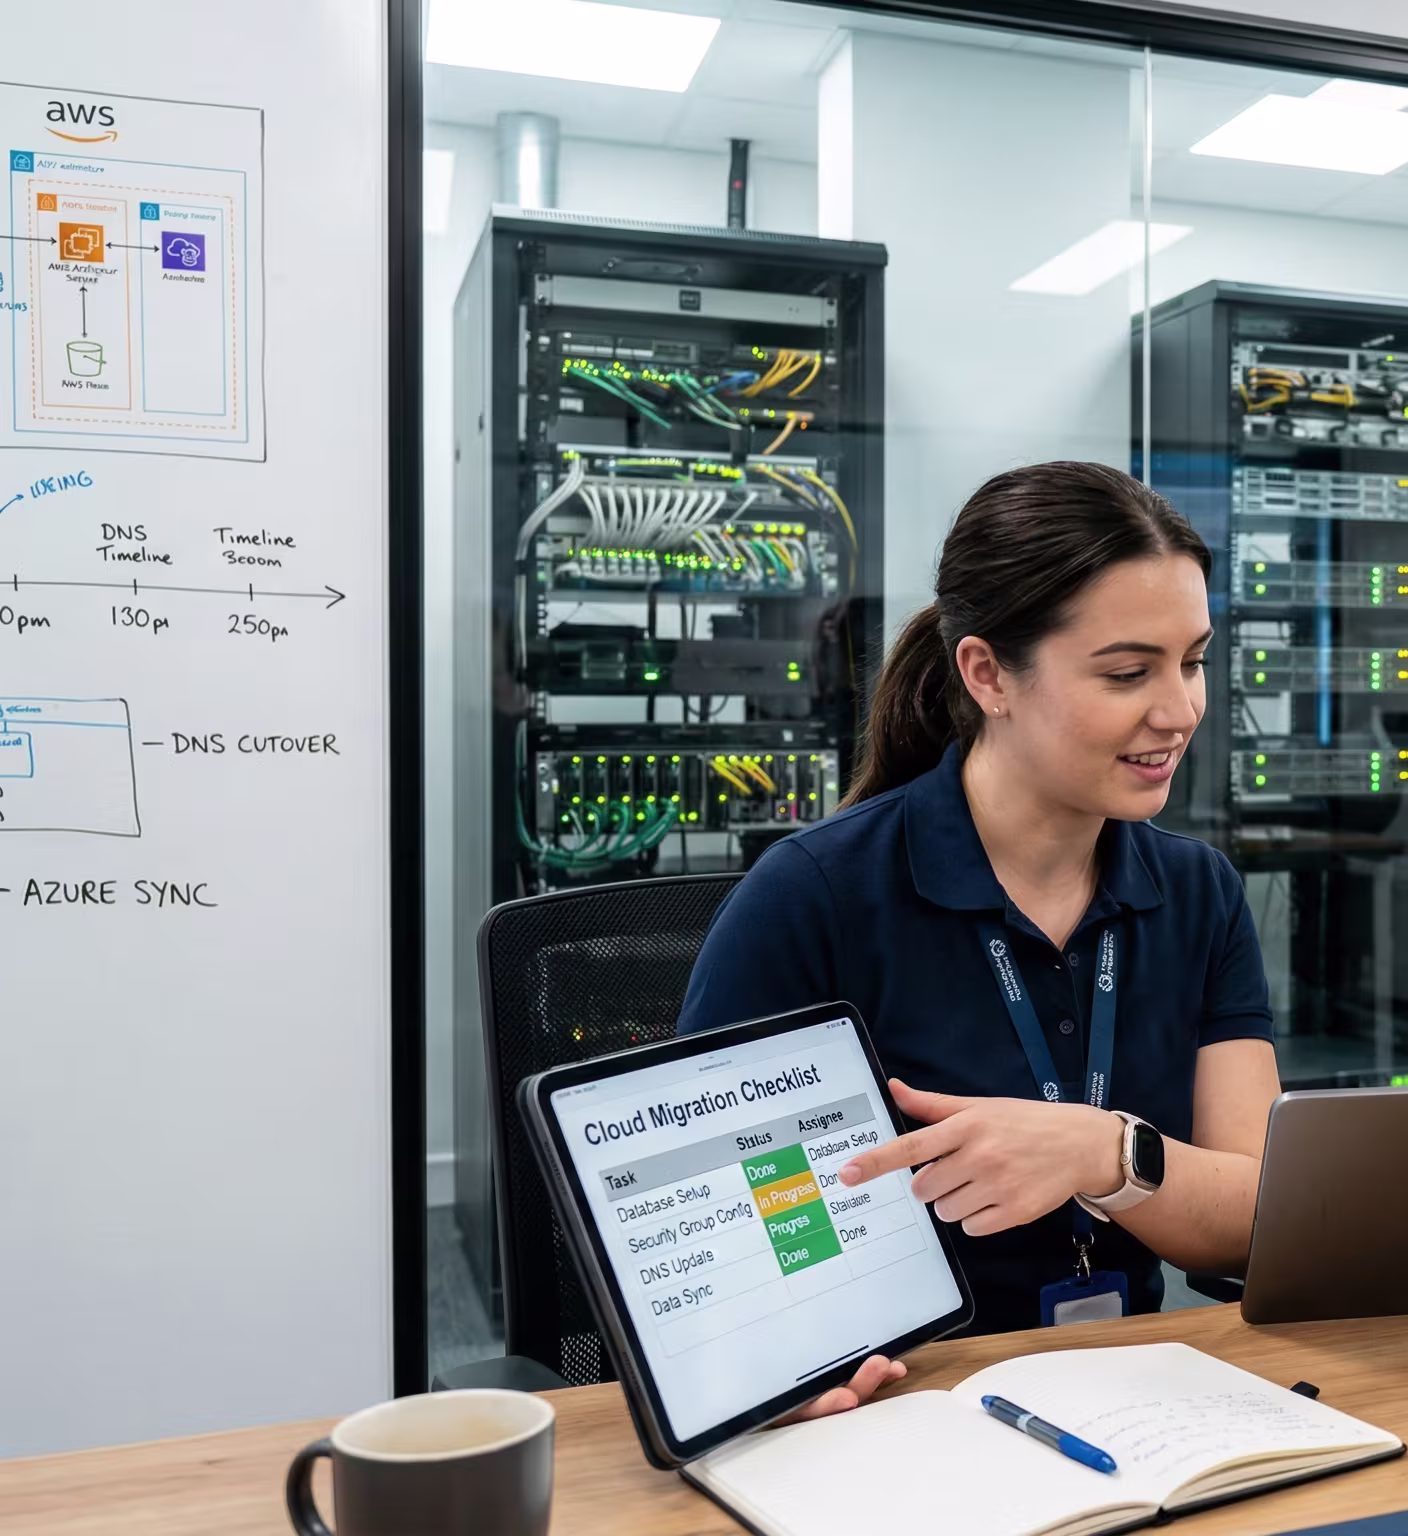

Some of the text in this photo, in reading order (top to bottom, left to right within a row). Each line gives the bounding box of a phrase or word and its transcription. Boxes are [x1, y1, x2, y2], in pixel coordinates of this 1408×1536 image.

[46, 100, 115, 127] aws
[101, 523, 148, 541] DNS
[213, 527, 296, 548] Timeline
[96, 544, 173, 565] Timeline
[171, 732, 340, 755] DNS CUTOVER
[23, 878, 218, 907] AZURE SYNC
[584, 1063, 822, 1146] Cloud Migration Checklist
[604, 1170, 638, 1191] Task
[798, 1110, 844, 1133] Assignee
[616, 1195, 676, 1223] Database
[675, 1184, 711, 1204] Setup
[746, 1162, 777, 1182] Done
[628, 1226, 678, 1254] Security
[679, 1215, 716, 1237] Group
[758, 1196, 771, 1210] In
[818, 1172, 839, 1189] Don
[639, 1262, 671, 1285] DNS
[671, 1249, 715, 1276] Update
[651, 1224, 868, 1316] Data Sync Done Done
